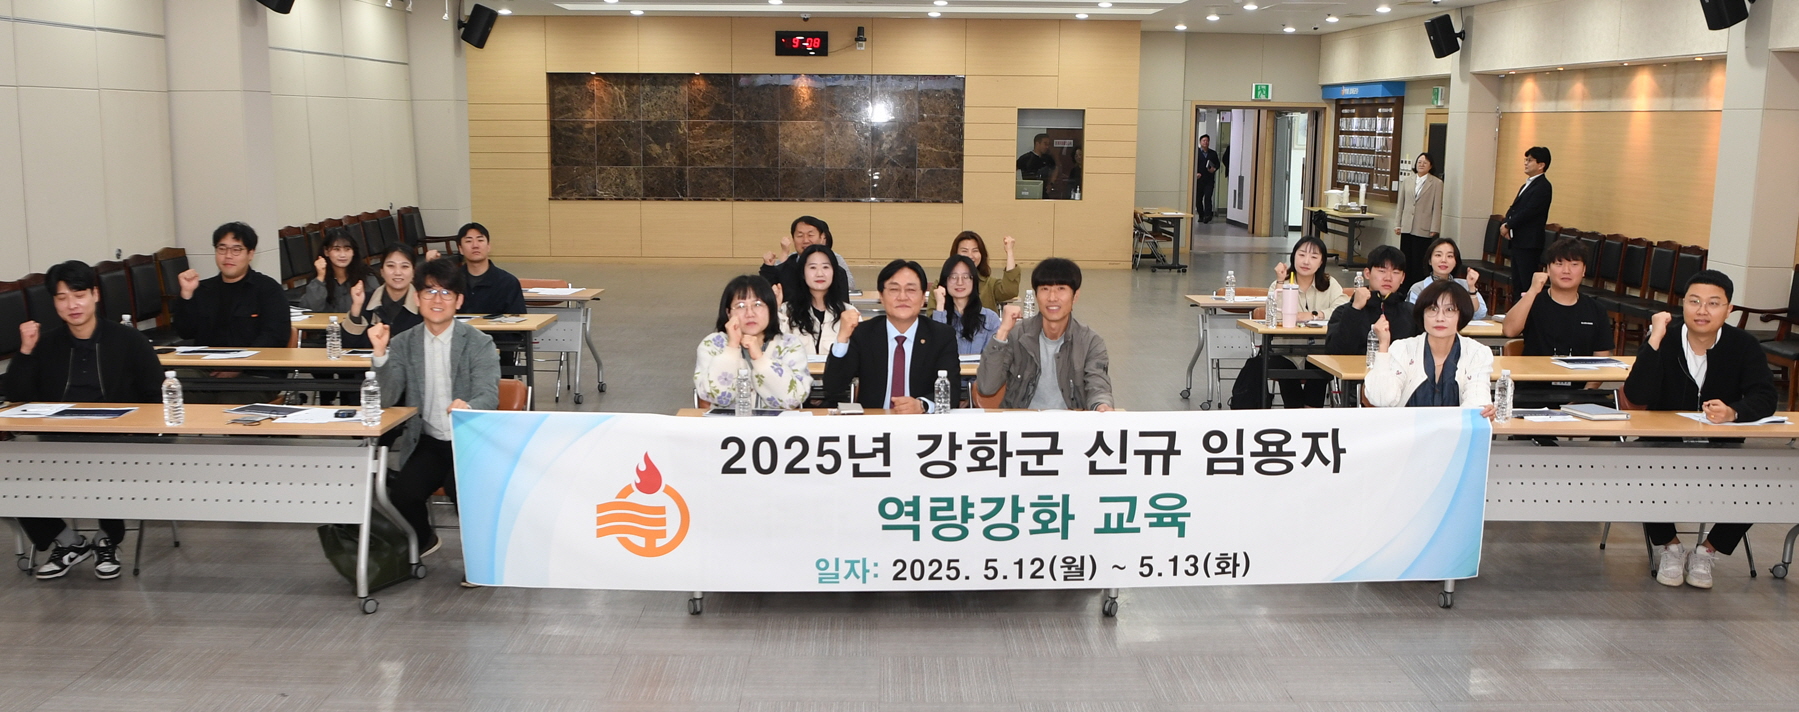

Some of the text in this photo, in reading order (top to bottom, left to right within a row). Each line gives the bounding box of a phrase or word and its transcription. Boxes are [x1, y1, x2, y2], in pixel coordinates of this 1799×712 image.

[720, 427, 1347, 480] 2025년 강화군 신규 임용자
[877, 492, 1192, 543] 역량강화 교육
[815, 557, 879, 584] 일자:
[892, 558, 970, 582] 2025.
[983, 554, 1097, 582] 5.12(월)
[1138, 551, 1251, 579] 5.13(화)
